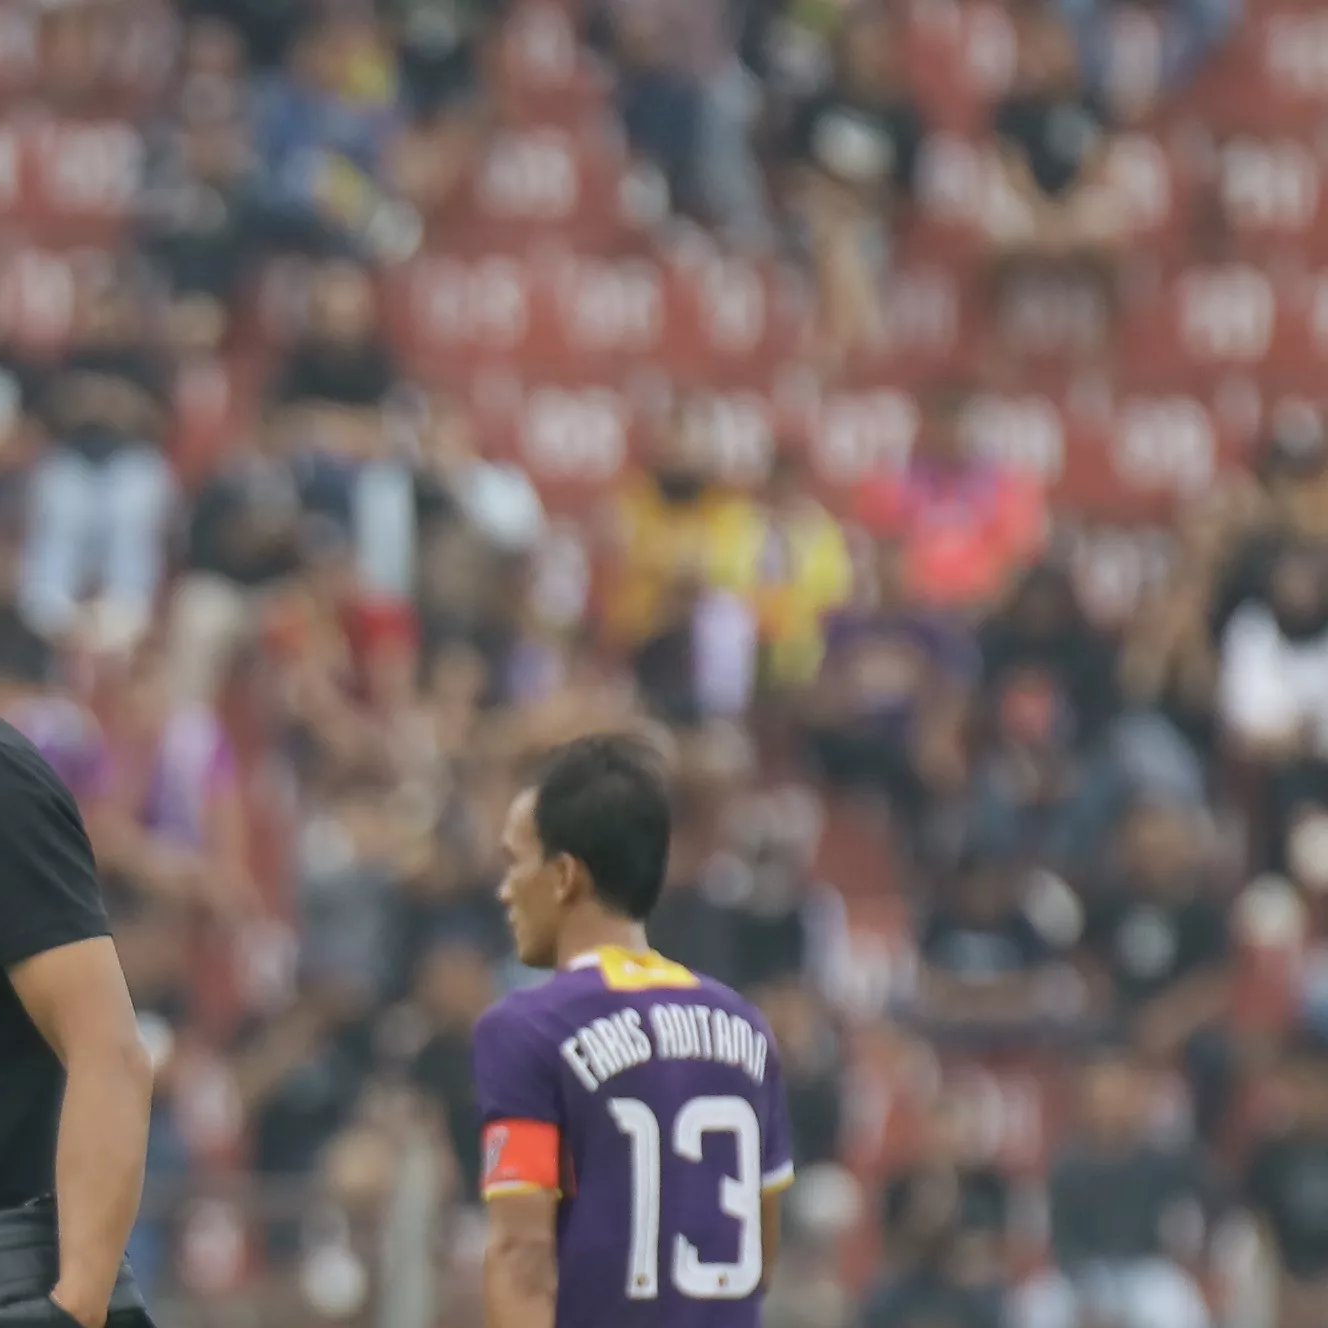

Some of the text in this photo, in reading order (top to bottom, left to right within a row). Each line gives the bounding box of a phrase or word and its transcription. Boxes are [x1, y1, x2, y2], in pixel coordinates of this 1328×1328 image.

[559, 1002, 768, 1093] FARIS ADITAMA
[606, 1094, 763, 1300] 13
